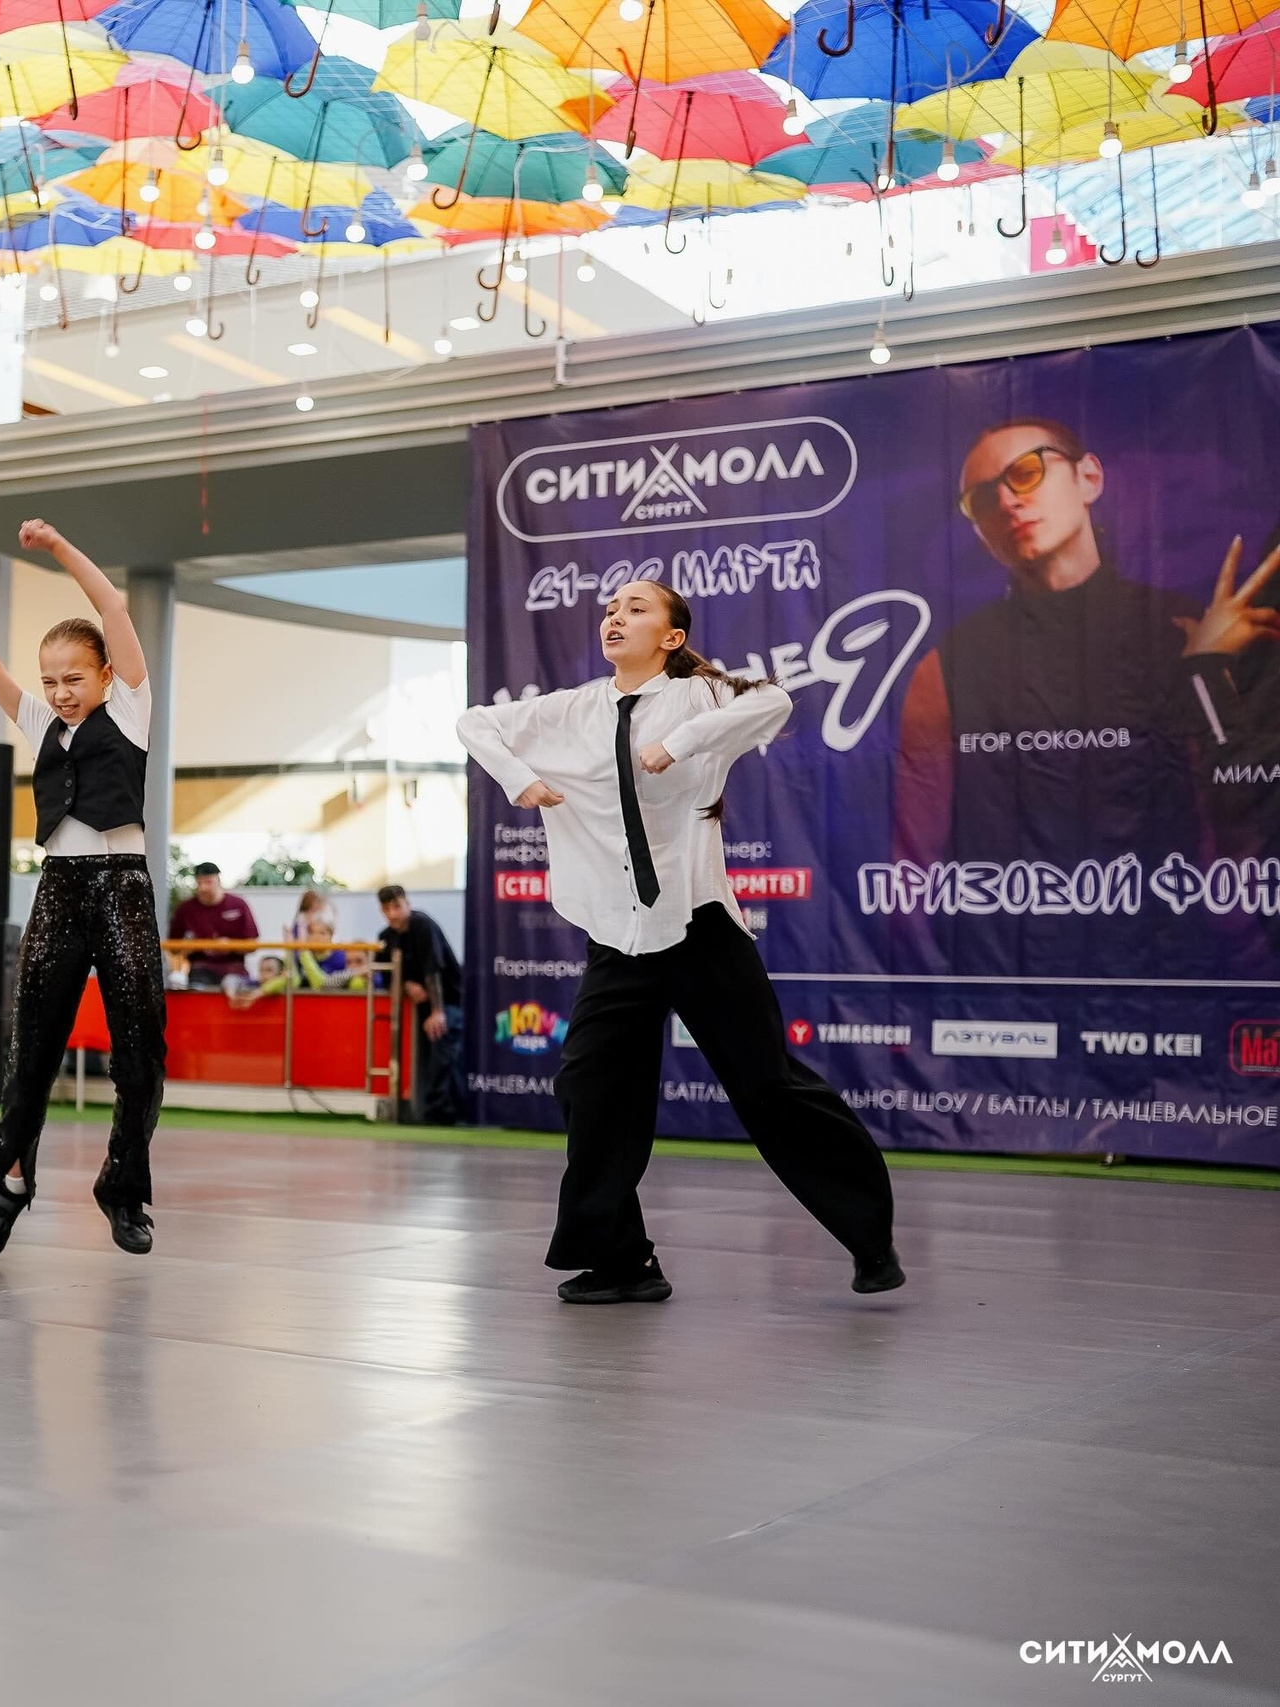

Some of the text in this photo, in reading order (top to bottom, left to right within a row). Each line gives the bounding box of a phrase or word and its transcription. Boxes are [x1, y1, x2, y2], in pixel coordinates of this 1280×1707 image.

[525, 438, 825, 505] СИТИ МОЛЛ
[633, 500, 695, 521] СУРГУТ
[671, 538, 821, 599] МАРТА
[959, 727, 1132, 754] ЕГОР СОКОЛОВ
[857, 852, 1143, 916] ПРИЗОВОЙ
[817, 1023, 912, 1046] YAMAGUCHI
[1080, 1030, 1203, 1058] TWO KEI
[912, 1091, 968, 1114] ШОУ
[987, 1094, 1070, 1118] БАТТЛЫ
[1092, 1098, 1279, 1127] ТАНЦЕВАЛЬНОЕ
